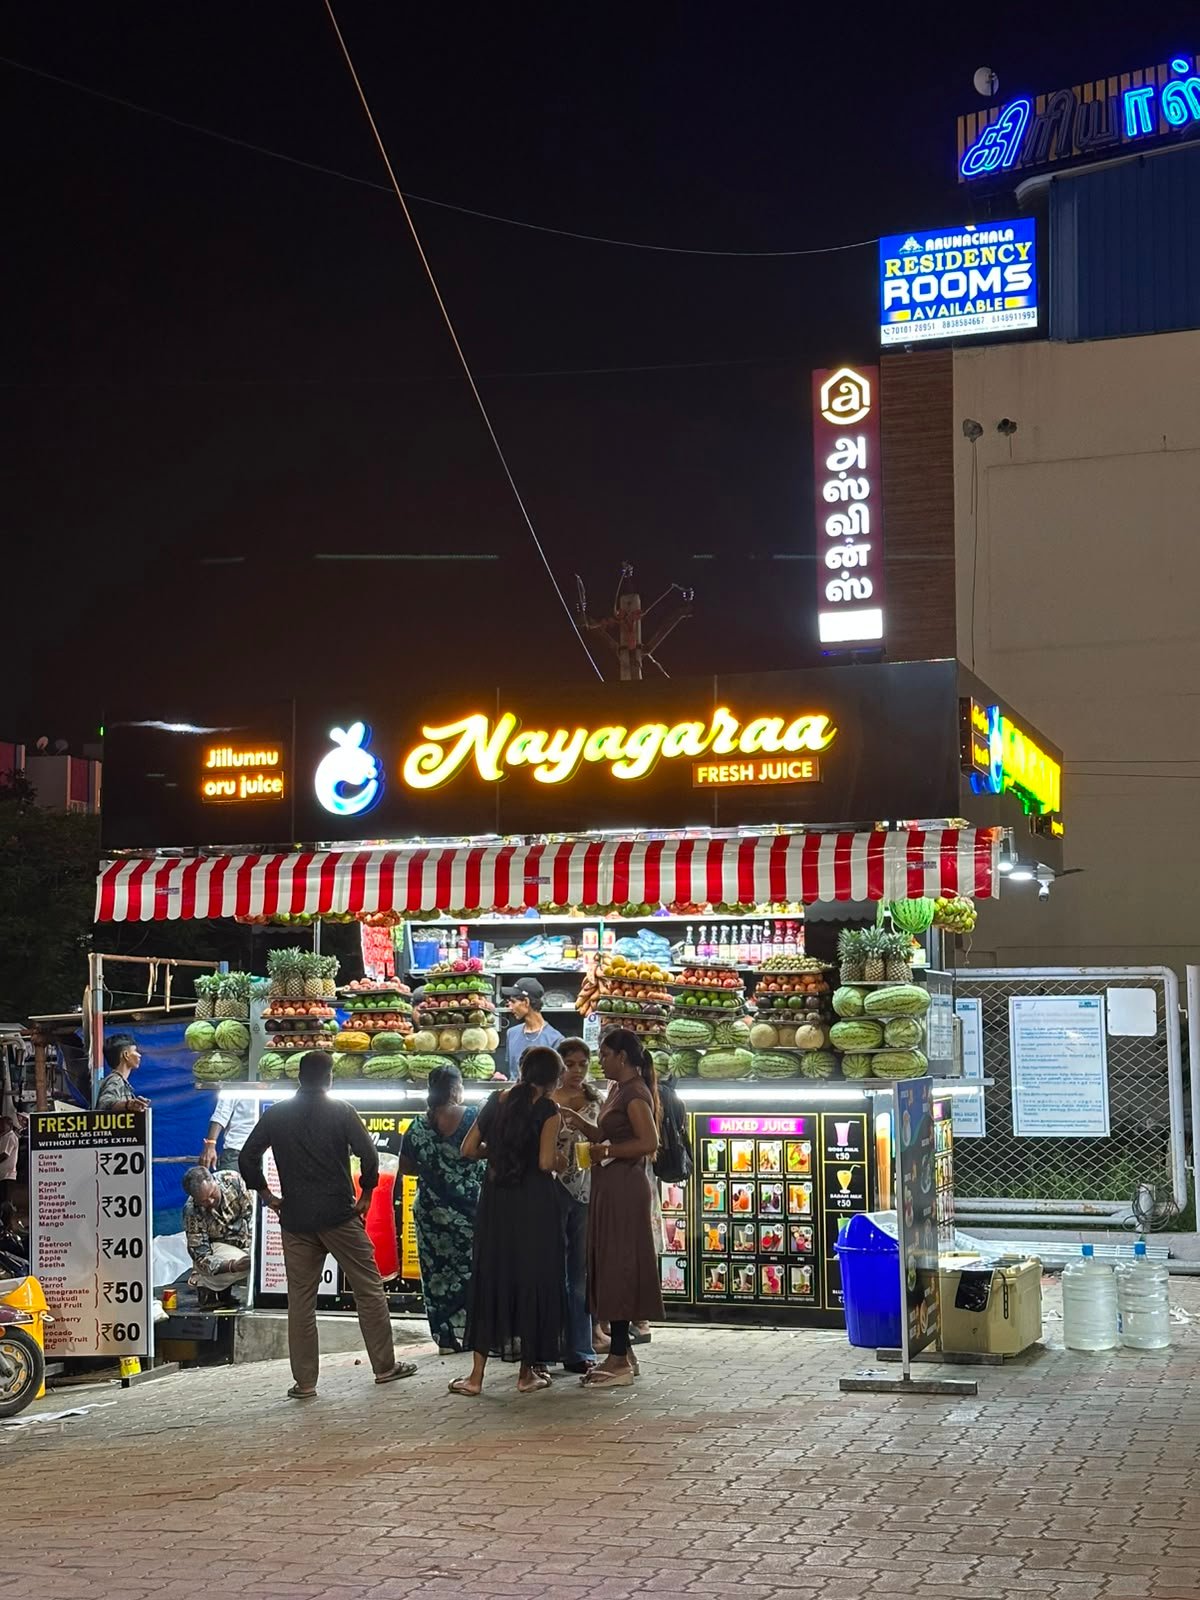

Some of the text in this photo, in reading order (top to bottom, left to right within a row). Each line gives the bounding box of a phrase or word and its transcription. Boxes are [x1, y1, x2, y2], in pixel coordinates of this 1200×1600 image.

[925, 228, 1015, 251] ARUNACHALA
[884, 241, 1033, 278] RESIDENCY
[883, 262, 1033, 311] ROOMS
[912, 297, 1004, 321] AVAILABLE
[206, 748, 279, 768] Jillunnu
[402, 706, 837, 790] Nayagaraa
[697, 759, 813, 784] FRESH JUICE
[204, 774, 282, 799] oru juice
[38, 1113, 135, 1133] FRESH JUICE
[367, 1118, 396, 1131] JUICE
[720, 1120, 797, 1132] MIXED JUICE
[38, 1139, 76, 1147] WITHOUT
[100, 1151, 145, 1176] ₹20
[38, 1180, 66, 1188] Papaya
[38, 1200, 76, 1208] Pineapple
[102, 1195, 142, 1218] ₹30
[102, 1237, 143, 1259] ₹40
[43, 1288, 90, 1296] omegranate
[103, 1281, 143, 1303] ₹50
[101, 1323, 140, 1342] ₹60
